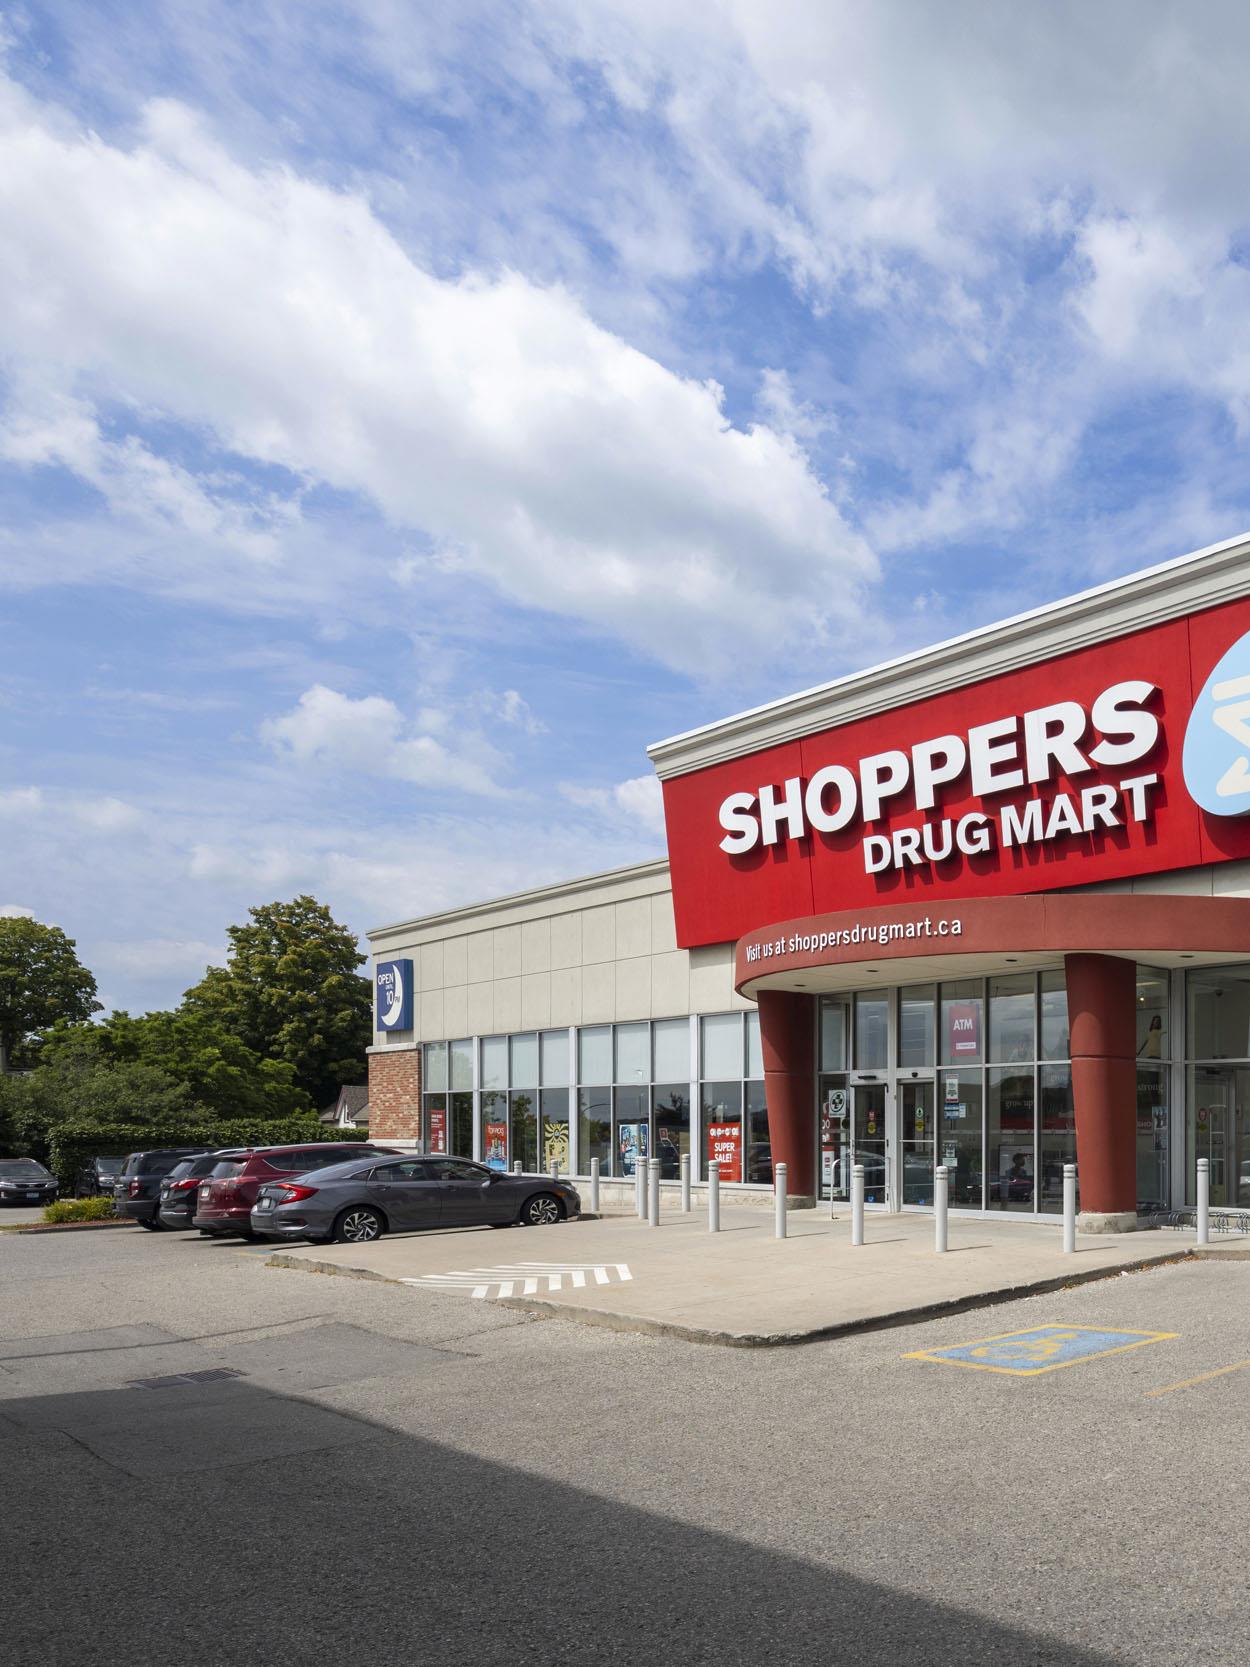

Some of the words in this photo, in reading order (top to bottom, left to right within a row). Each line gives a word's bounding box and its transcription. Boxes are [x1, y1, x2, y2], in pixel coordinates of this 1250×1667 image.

[718, 681, 1159, 855] SHOPPERS
[863, 813, 990, 874] DRUG
[1001, 774, 1158, 848] MART
[746, 943, 761, 962] Visit
[763, 942, 773, 957] us
[775, 936, 786, 955] at
[789, 917, 962, 953] shoppersdrugmart.ca
[378, 973, 394, 985] OPEN
[386, 990, 394, 1005] 10
[953, 1018, 974, 1031] ATM
[714, 1142, 735, 1152] SUPER
[714, 1153, 732, 1163] SALE!
